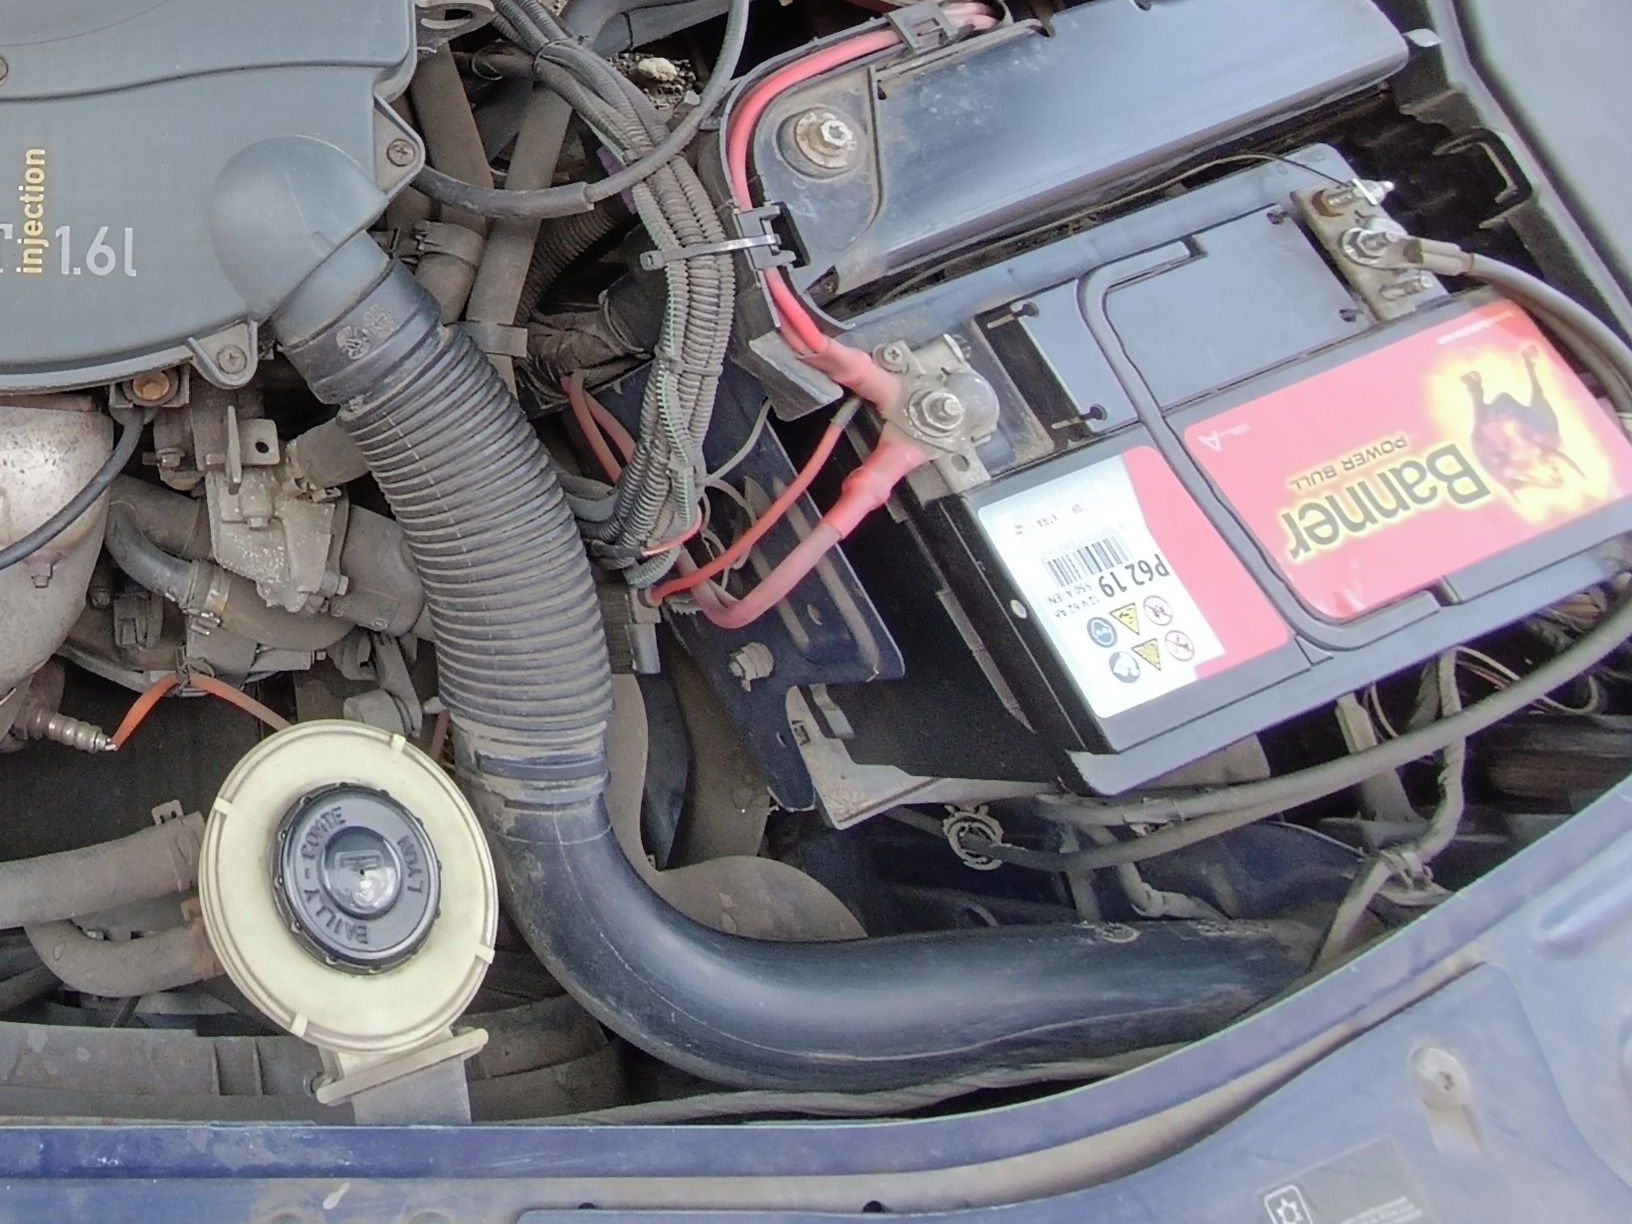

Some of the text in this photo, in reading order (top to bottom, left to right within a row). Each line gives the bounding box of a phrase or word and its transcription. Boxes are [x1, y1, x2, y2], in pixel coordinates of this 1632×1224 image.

[16, 148, 49, 274] injection
[55, 225, 137, 277] 1.6l
[1290, 436, 1408, 491] POWER BULL
[1281, 443, 1491, 559] Banner
[1098, 553, 1170, 598] P62 19
[300, 806, 346, 860] COMTE
[397, 835, 423, 893] LYON
[304, 889, 369, 944] BAILLY
